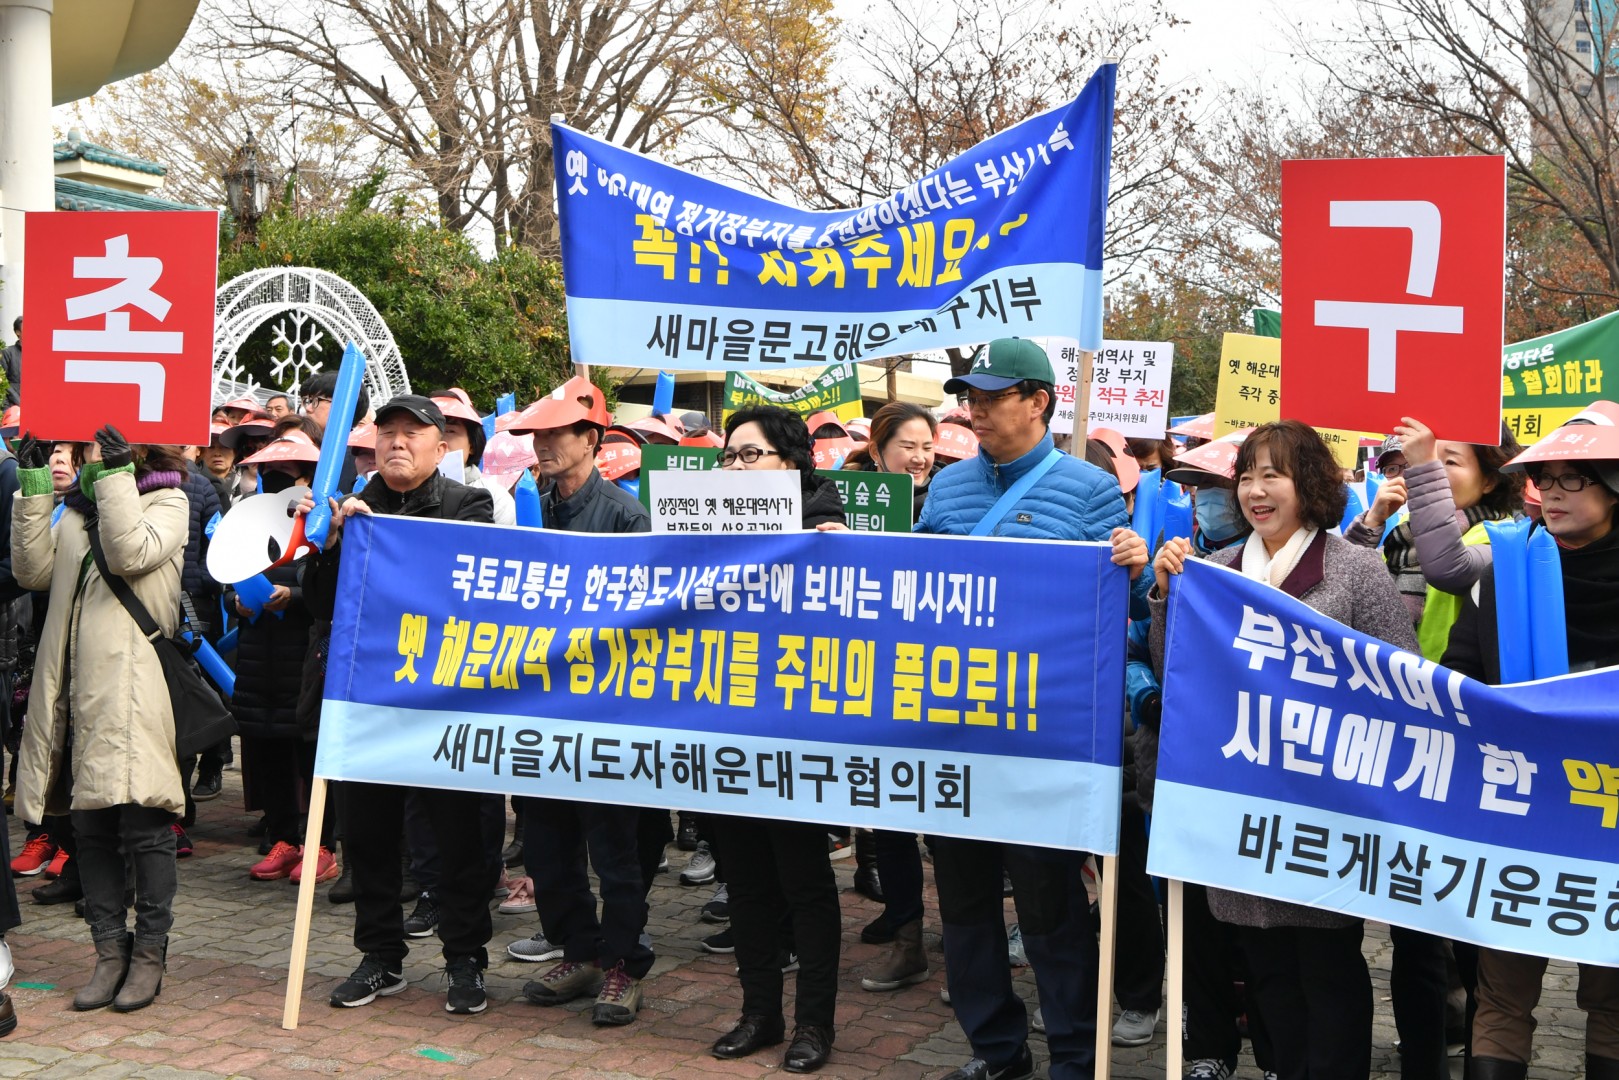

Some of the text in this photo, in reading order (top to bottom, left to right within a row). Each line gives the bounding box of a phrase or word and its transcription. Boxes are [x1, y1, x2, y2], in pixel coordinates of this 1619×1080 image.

[566, 150, 588, 195] 옛
[676, 200, 815, 250] 정거장부지를
[1314, 200, 1464, 394] 구
[52, 233, 184, 422] 촉
[972, 344, 992, 369] A
[1061, 347, 1156, 366] 해대역사 및
[1066, 367, 1147, 385] 정장 부지
[1229, 359, 1241, 375] 옛
[1502, 343, 1555, 370] 공단은
[1521, 359, 1603, 396] 철회하라
[1054, 385, 1164, 407] 공원 적극 추진
[1239, 385, 1280, 404] 즉각 중
[657, 498, 793, 516] 상징적인 옛 해운대역사가
[452, 554, 997, 628] 국토교통부, 한국철도시설공단에 보내는 메시지!!
[394, 613, 1039, 731] 옛 해운대역 정거장부지를 주민의 품으로!!
[1232, 605, 1472, 727] 부산시여!
[433, 723, 972, 817] 새마을지도자해운대구협의회
[1221, 691, 1456, 803] 시민에게
[1478, 743, 1538, 816] 한
[1237, 813, 1619, 937] 바르게살기운동
